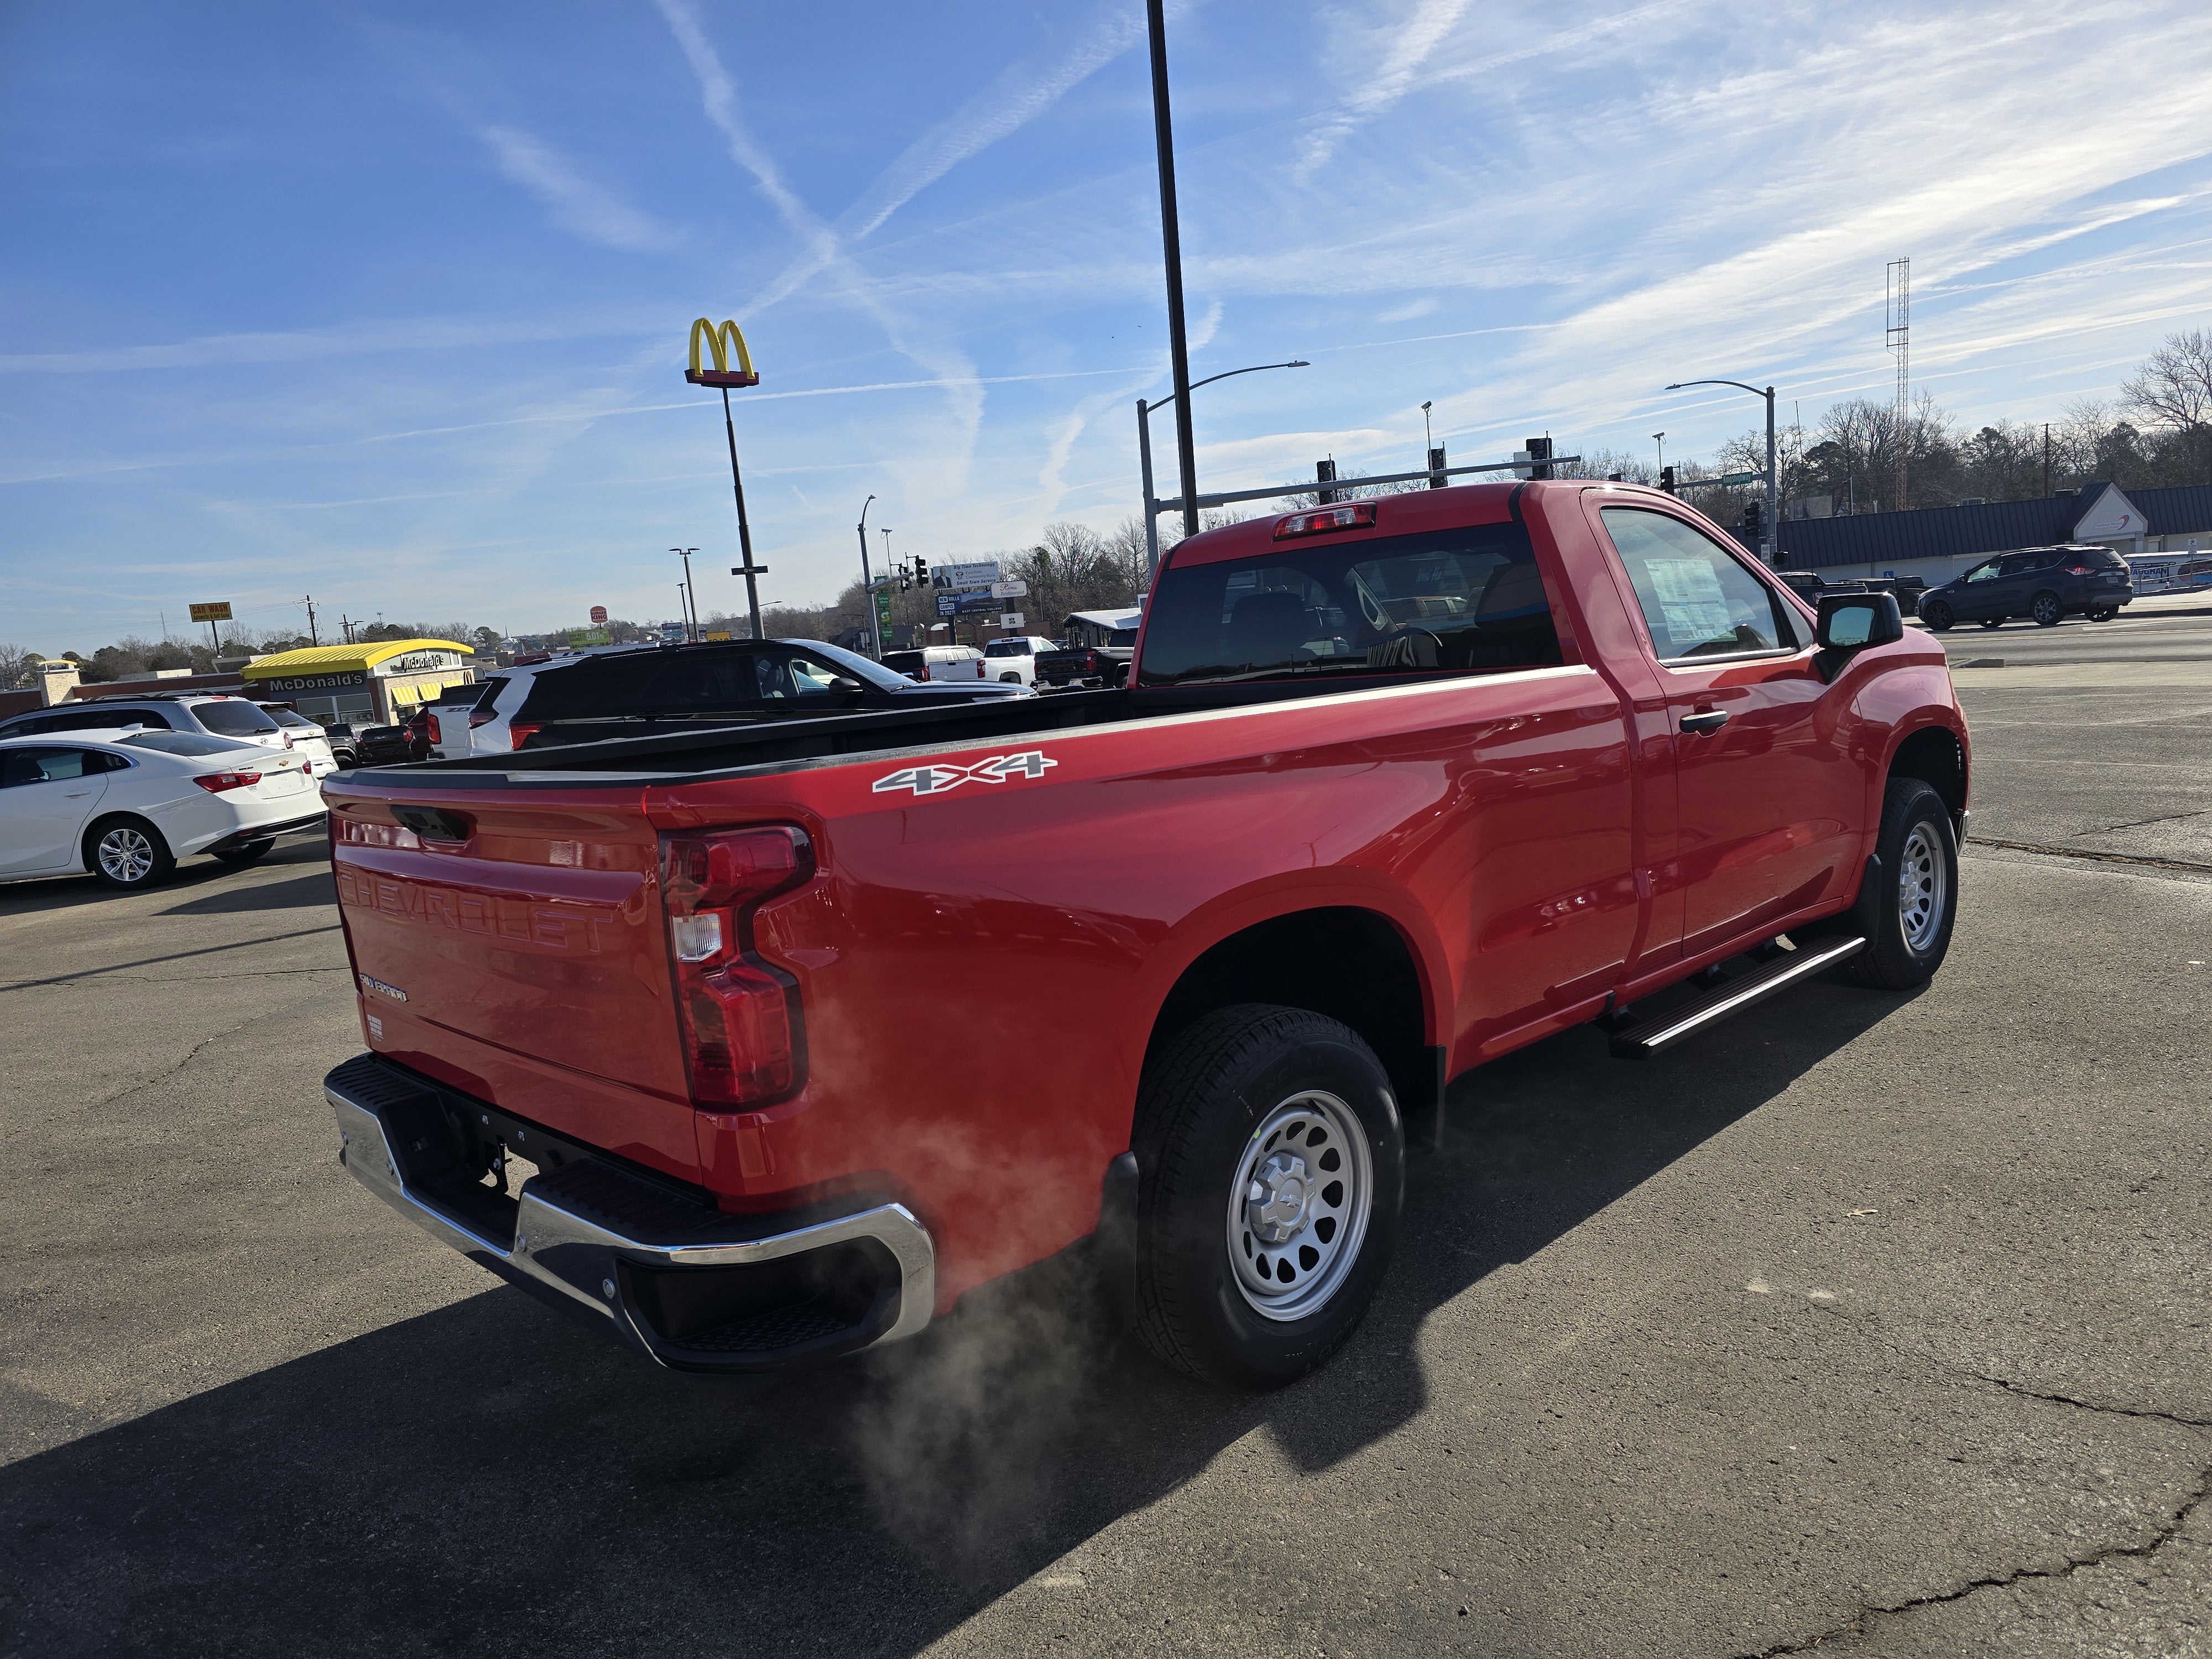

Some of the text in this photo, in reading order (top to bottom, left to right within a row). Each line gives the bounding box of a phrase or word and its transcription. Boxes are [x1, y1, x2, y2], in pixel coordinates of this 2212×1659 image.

[1723, 474, 1751, 485] Kingshighway
[192, 604, 228, 614] CAR WASH
[403, 655, 444, 669] McDonald's
[270, 674, 363, 691] McDonald's
[336, 868, 613, 953] CHEVROLET
